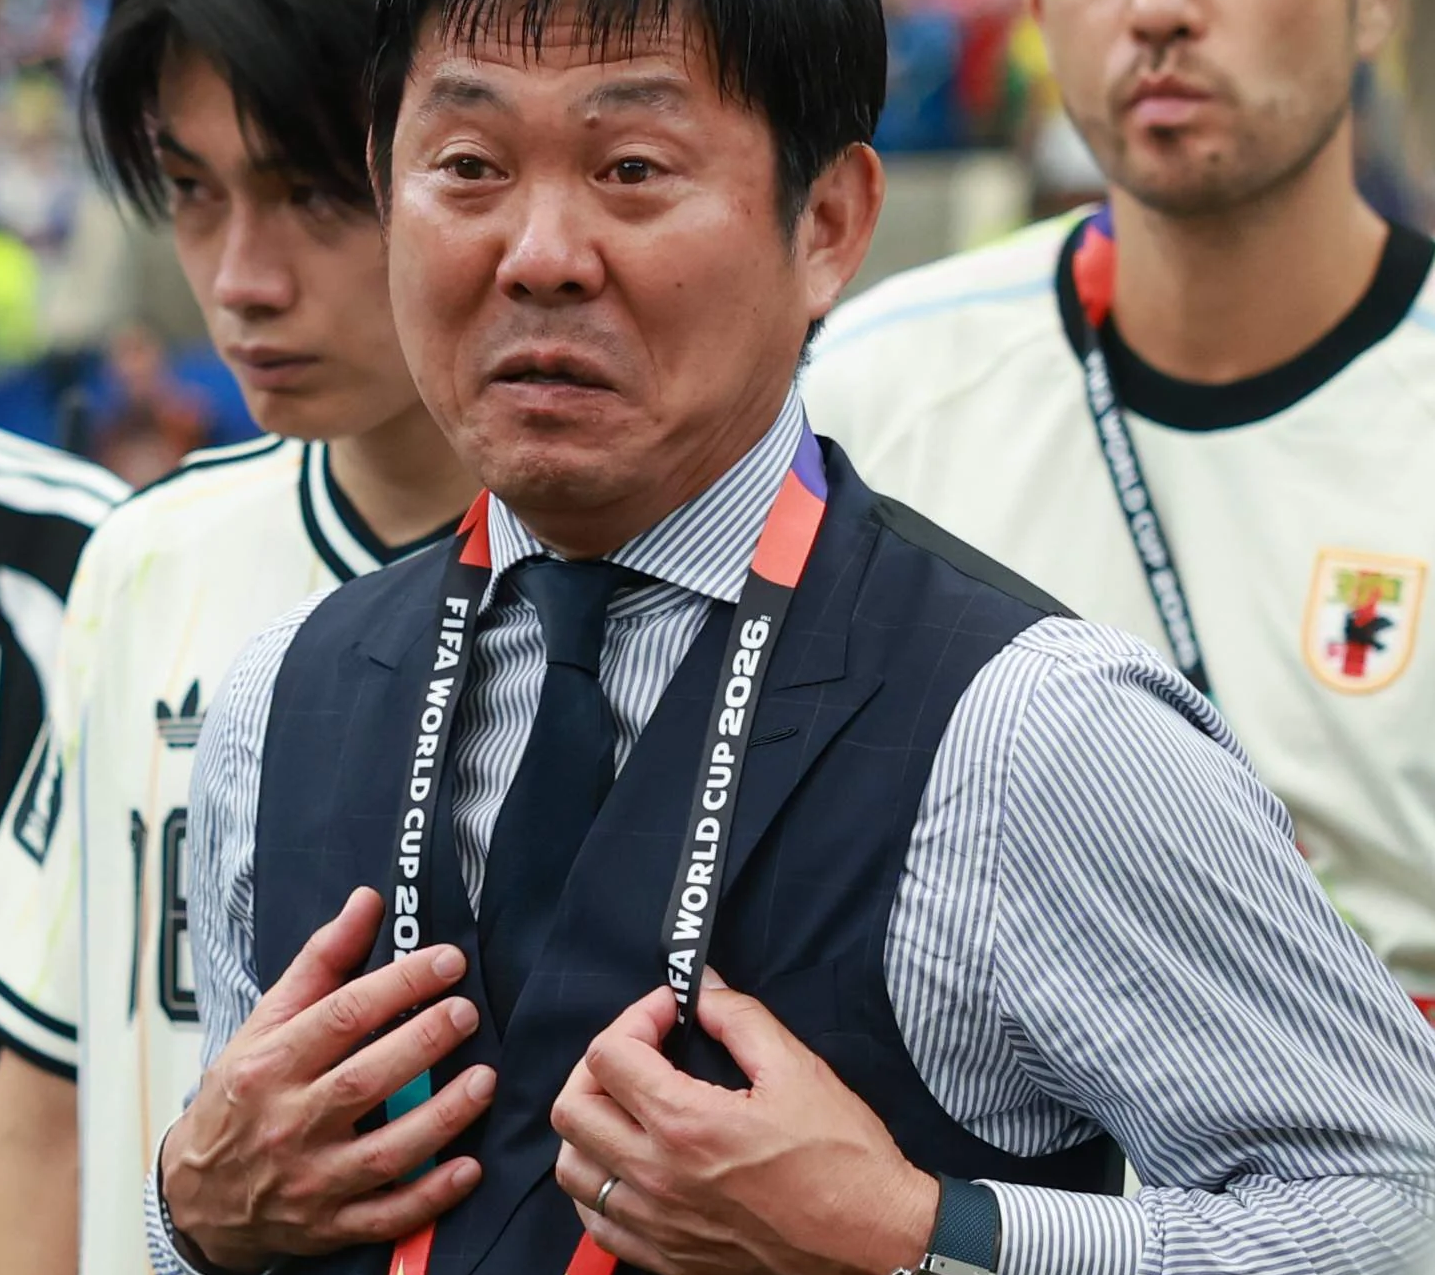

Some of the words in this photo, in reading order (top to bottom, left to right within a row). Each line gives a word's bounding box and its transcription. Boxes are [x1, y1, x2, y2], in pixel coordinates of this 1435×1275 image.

[434, 597, 469, 671] FIFA
[410, 677, 454, 802] WORLD
[397, 808, 425, 879] CUP
[672, 816, 721, 941] WORLD
[702, 744, 735, 812] CUP
